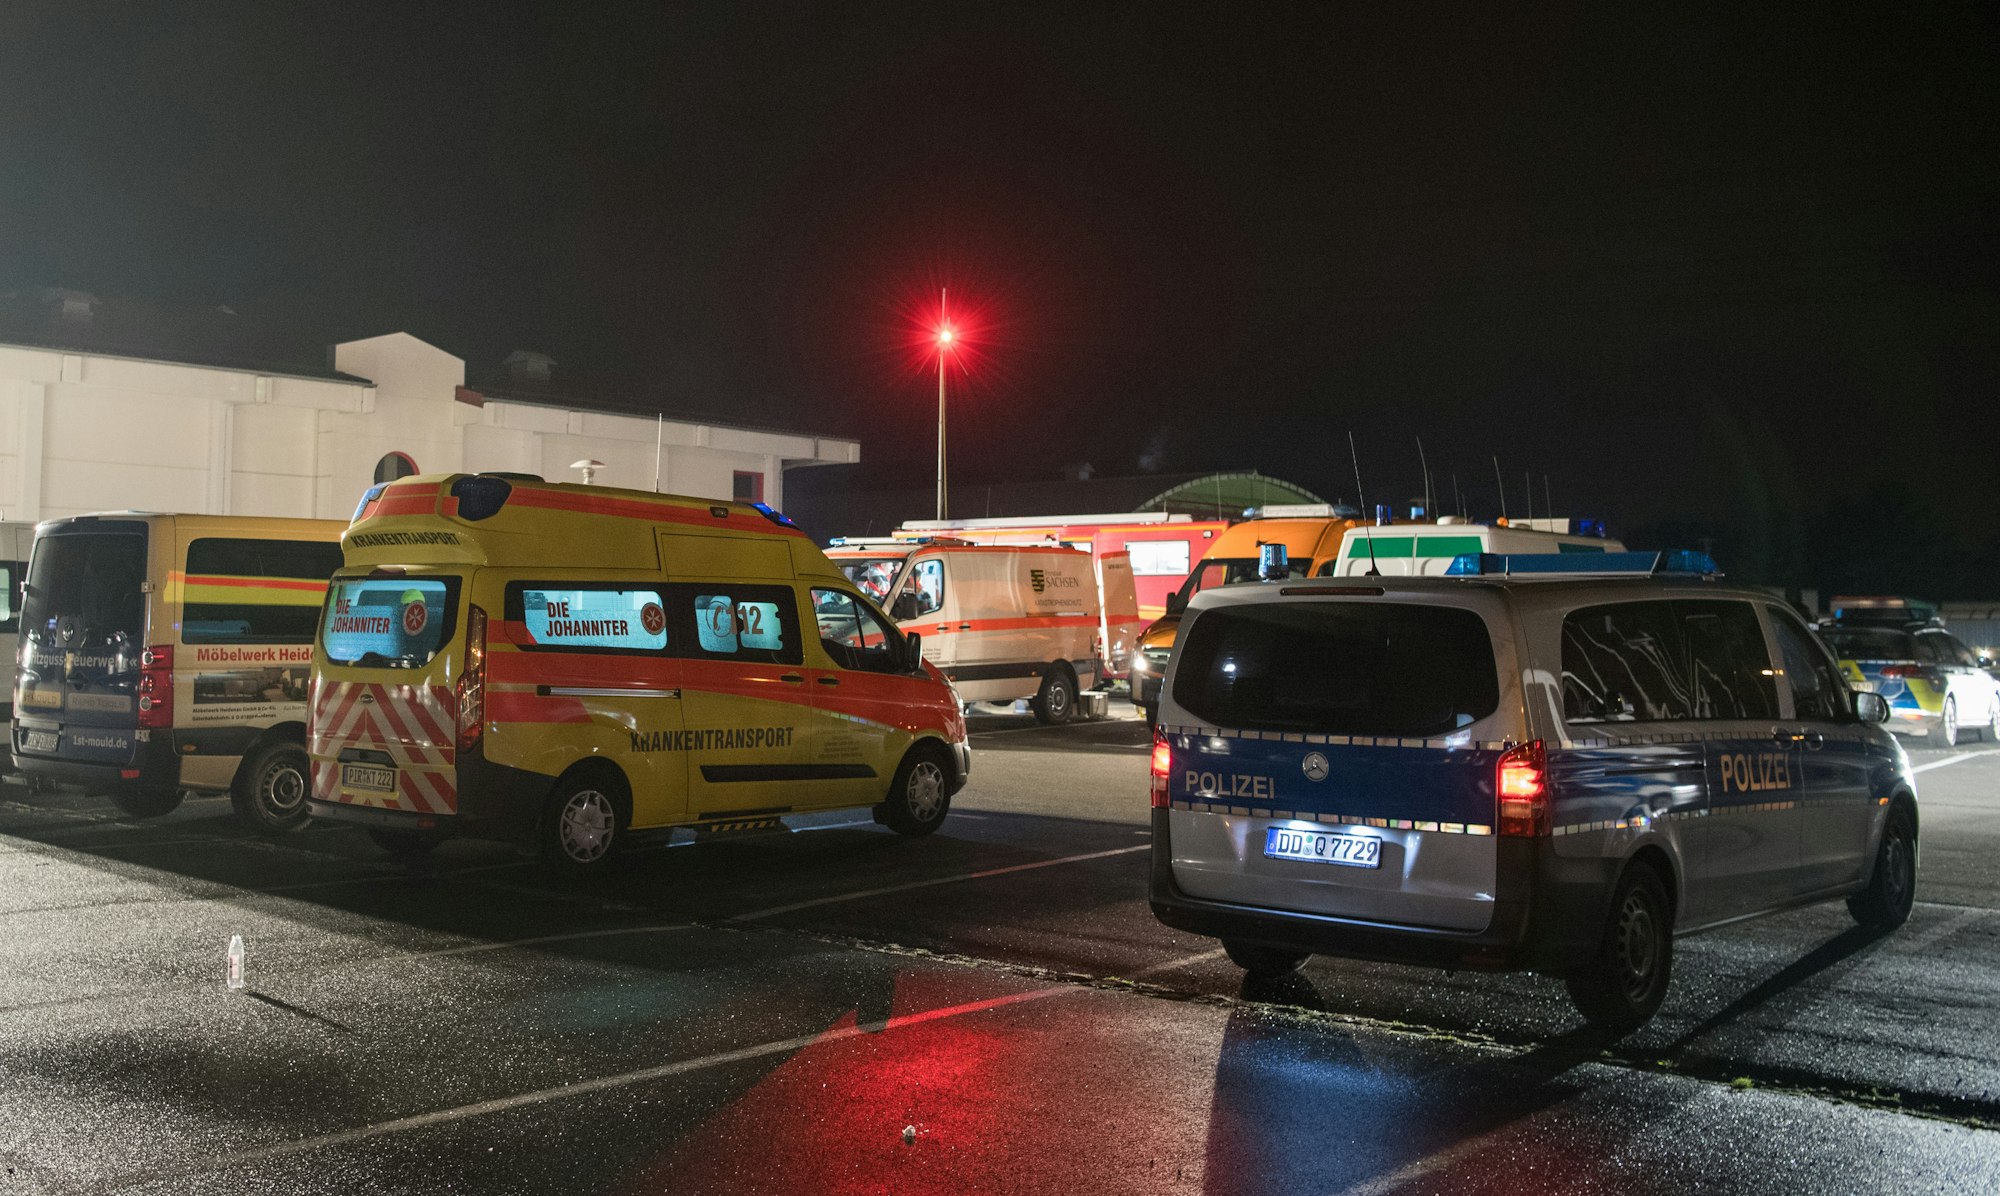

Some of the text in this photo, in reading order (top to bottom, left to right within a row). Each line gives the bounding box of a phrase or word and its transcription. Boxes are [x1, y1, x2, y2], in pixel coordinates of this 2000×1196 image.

[351, 531, 461, 548] KRANKENTRANSPORT
[1046, 576, 1080, 589] SACHSEN
[335, 599, 352, 615] DIE
[547, 601, 570, 618] DIE
[331, 617, 391, 634] JOHANNITER
[726, 603, 764, 635] 112
[546, 620, 629, 637] JOHANNITER
[197, 648, 276, 661] Möbelwerk
[73, 735, 128, 749] 1st-mould.de
[630, 727, 794, 752] KRANKENTRANSPORT
[349, 768, 363, 784] PIR
[377, 772, 391, 786] 222
[1720, 753, 1791, 793] POLIZEI
[1185, 770, 1275, 799] POLIZEI
[1278, 833, 1303, 854] DD
[1314, 836, 1326, 857] Q
[1331, 837, 1379, 862] 7729
